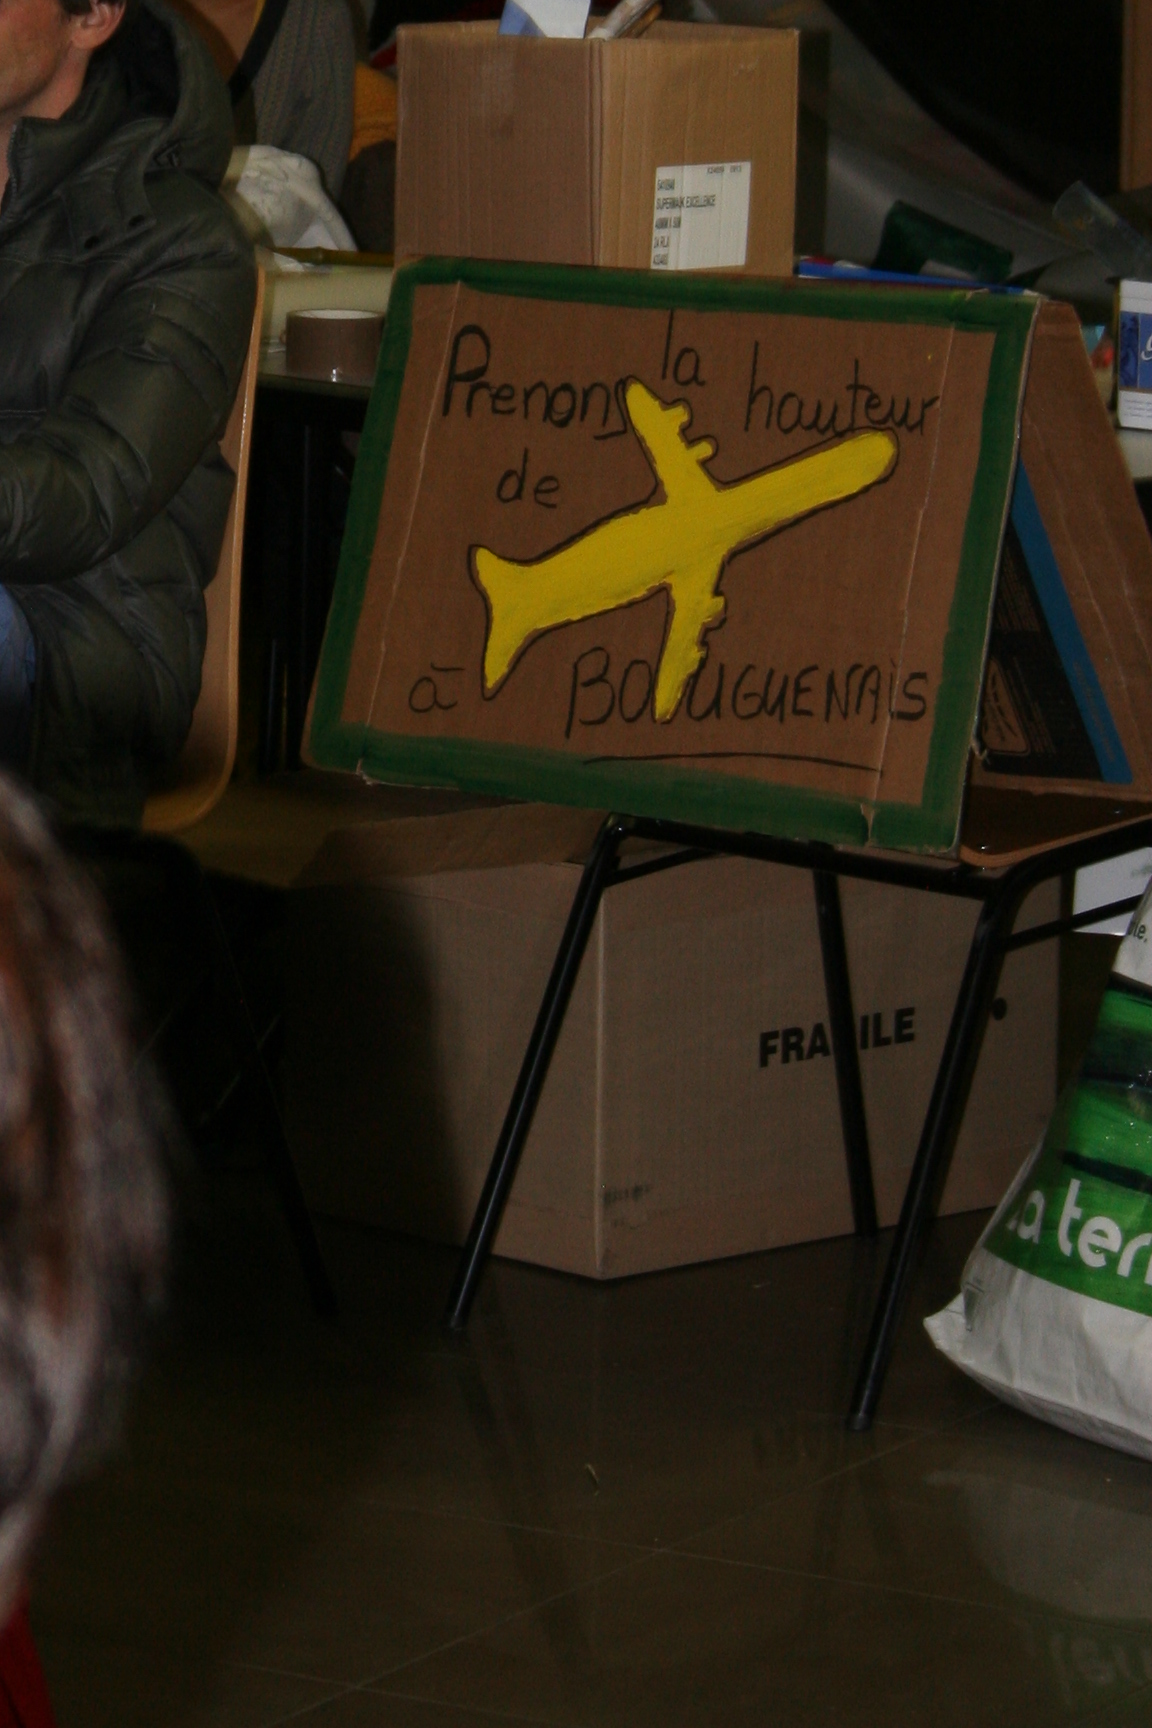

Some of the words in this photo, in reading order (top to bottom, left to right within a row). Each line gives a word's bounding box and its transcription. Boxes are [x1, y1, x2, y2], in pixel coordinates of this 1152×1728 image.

[442, 324, 629, 440] Prenons
[662, 310, 705, 386] la
[745, 341, 941, 436] hauteur
[496, 449, 561, 508] de
[759, 1007, 915, 1067] FRAILE
